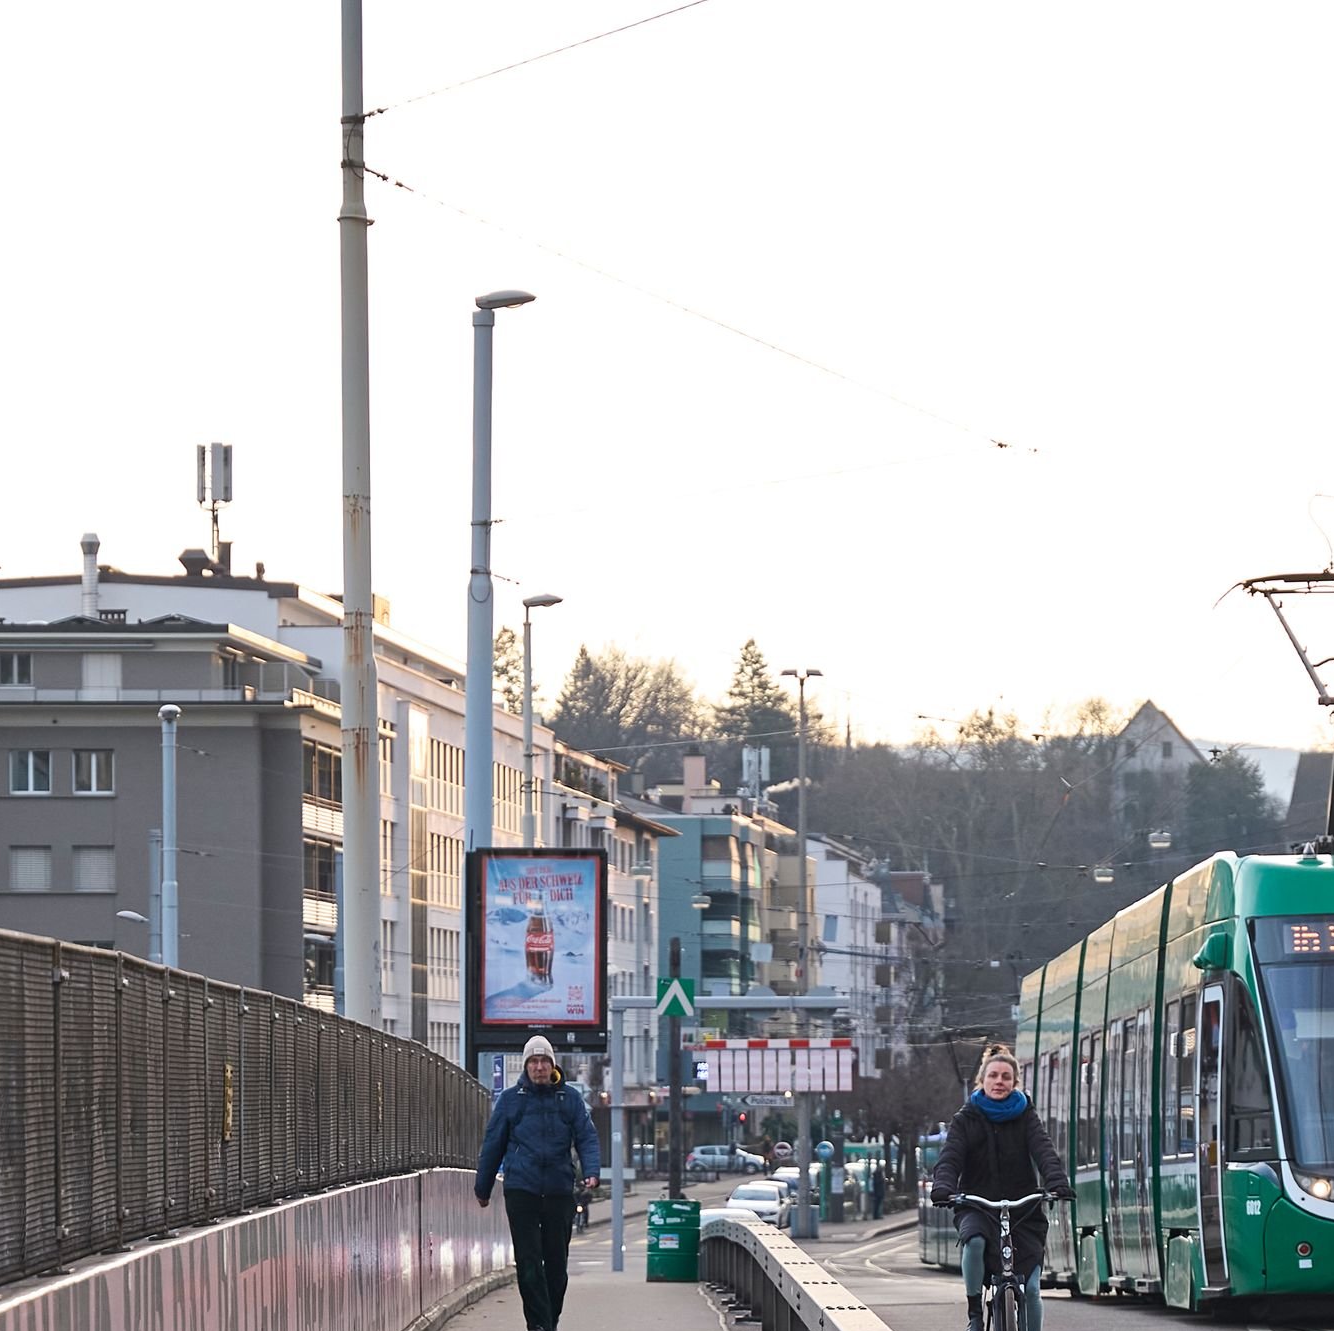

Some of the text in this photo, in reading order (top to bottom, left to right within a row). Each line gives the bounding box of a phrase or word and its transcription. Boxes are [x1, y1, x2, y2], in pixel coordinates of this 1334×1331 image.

[518, 876, 538, 890] DER
[539, 871, 583, 889] SCHWEIZ
[550, 887, 573, 902] DICH
[566, 1006, 585, 1015] WIN
[1245, 1199, 1262, 1216] 6012
